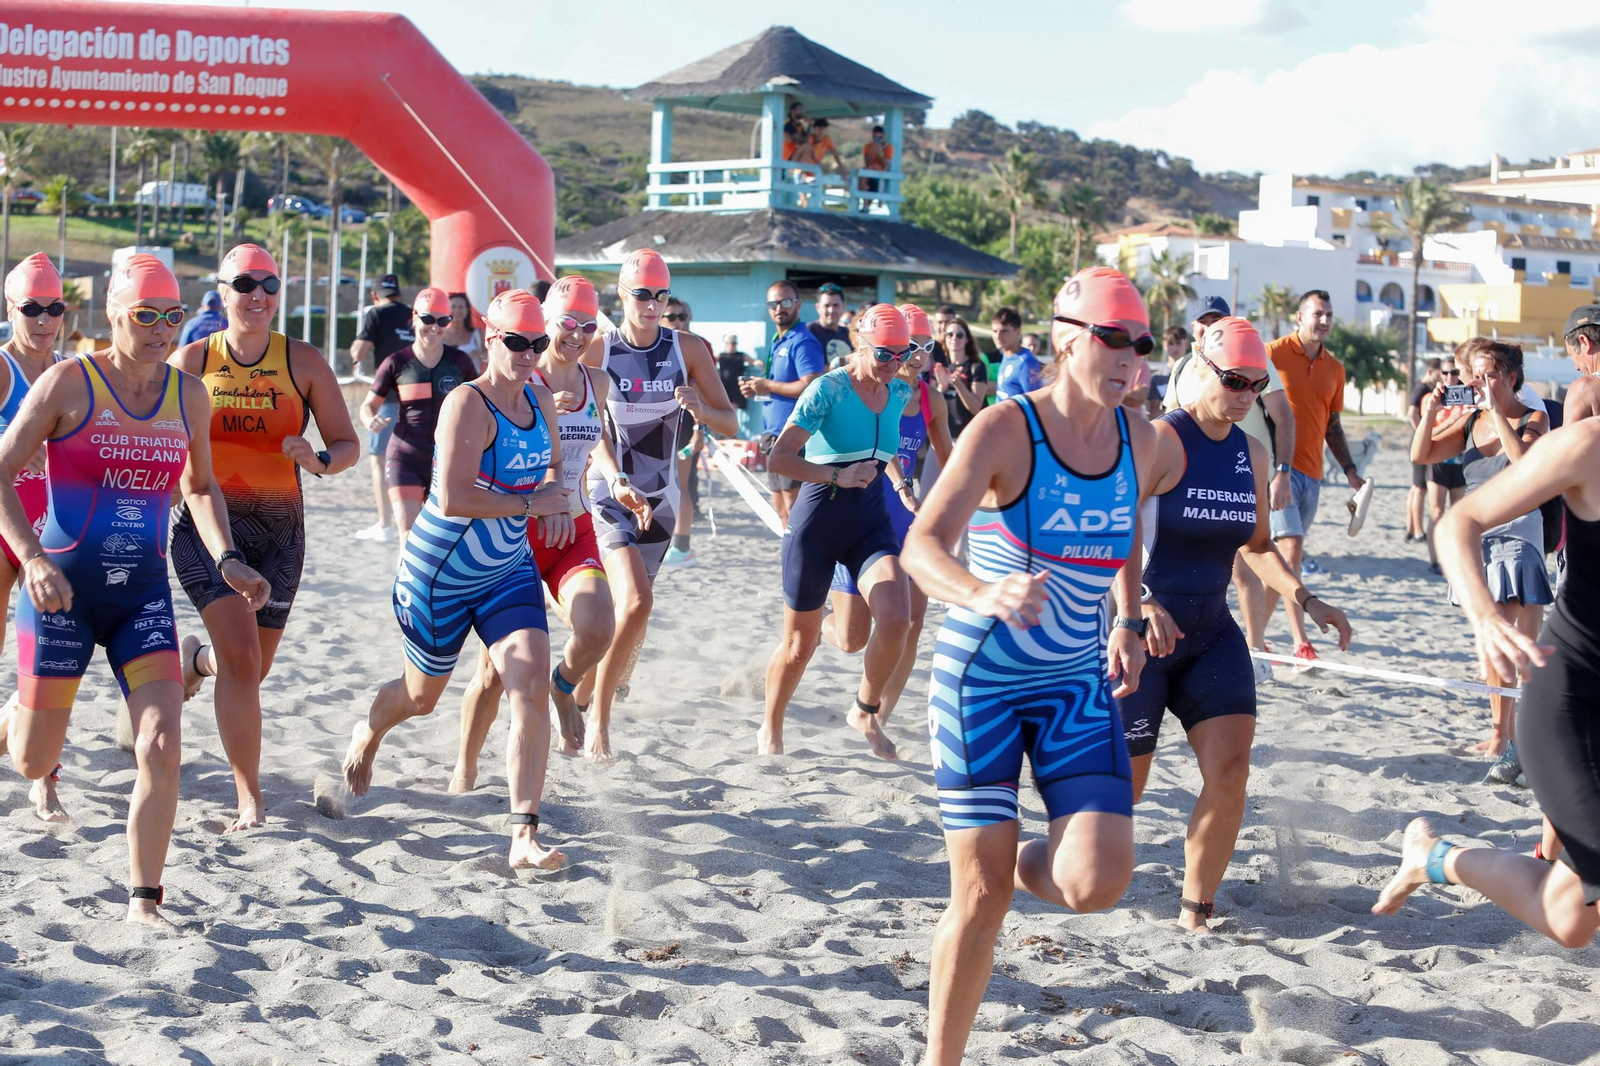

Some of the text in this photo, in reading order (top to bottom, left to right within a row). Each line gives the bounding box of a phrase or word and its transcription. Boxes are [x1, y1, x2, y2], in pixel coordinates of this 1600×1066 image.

[0, 22, 290, 66] Delegación de Deportes
[49, 65, 170, 93] Ayuntamiento
[172, 70, 195, 94] de
[197, 71, 231, 95] San
[233, 72, 288, 98] Roque
[212, 395, 275, 410] BRILLA
[222, 414, 268, 434] MICA
[90, 433, 187, 450] CLUB TRIATLON
[99, 446, 181, 463] CHICLANA
[504, 447, 552, 470] ADS
[102, 467, 170, 491] NOELIA
[1040, 505, 1133, 532] ADS
[1060, 545, 1113, 560] PILUKA
